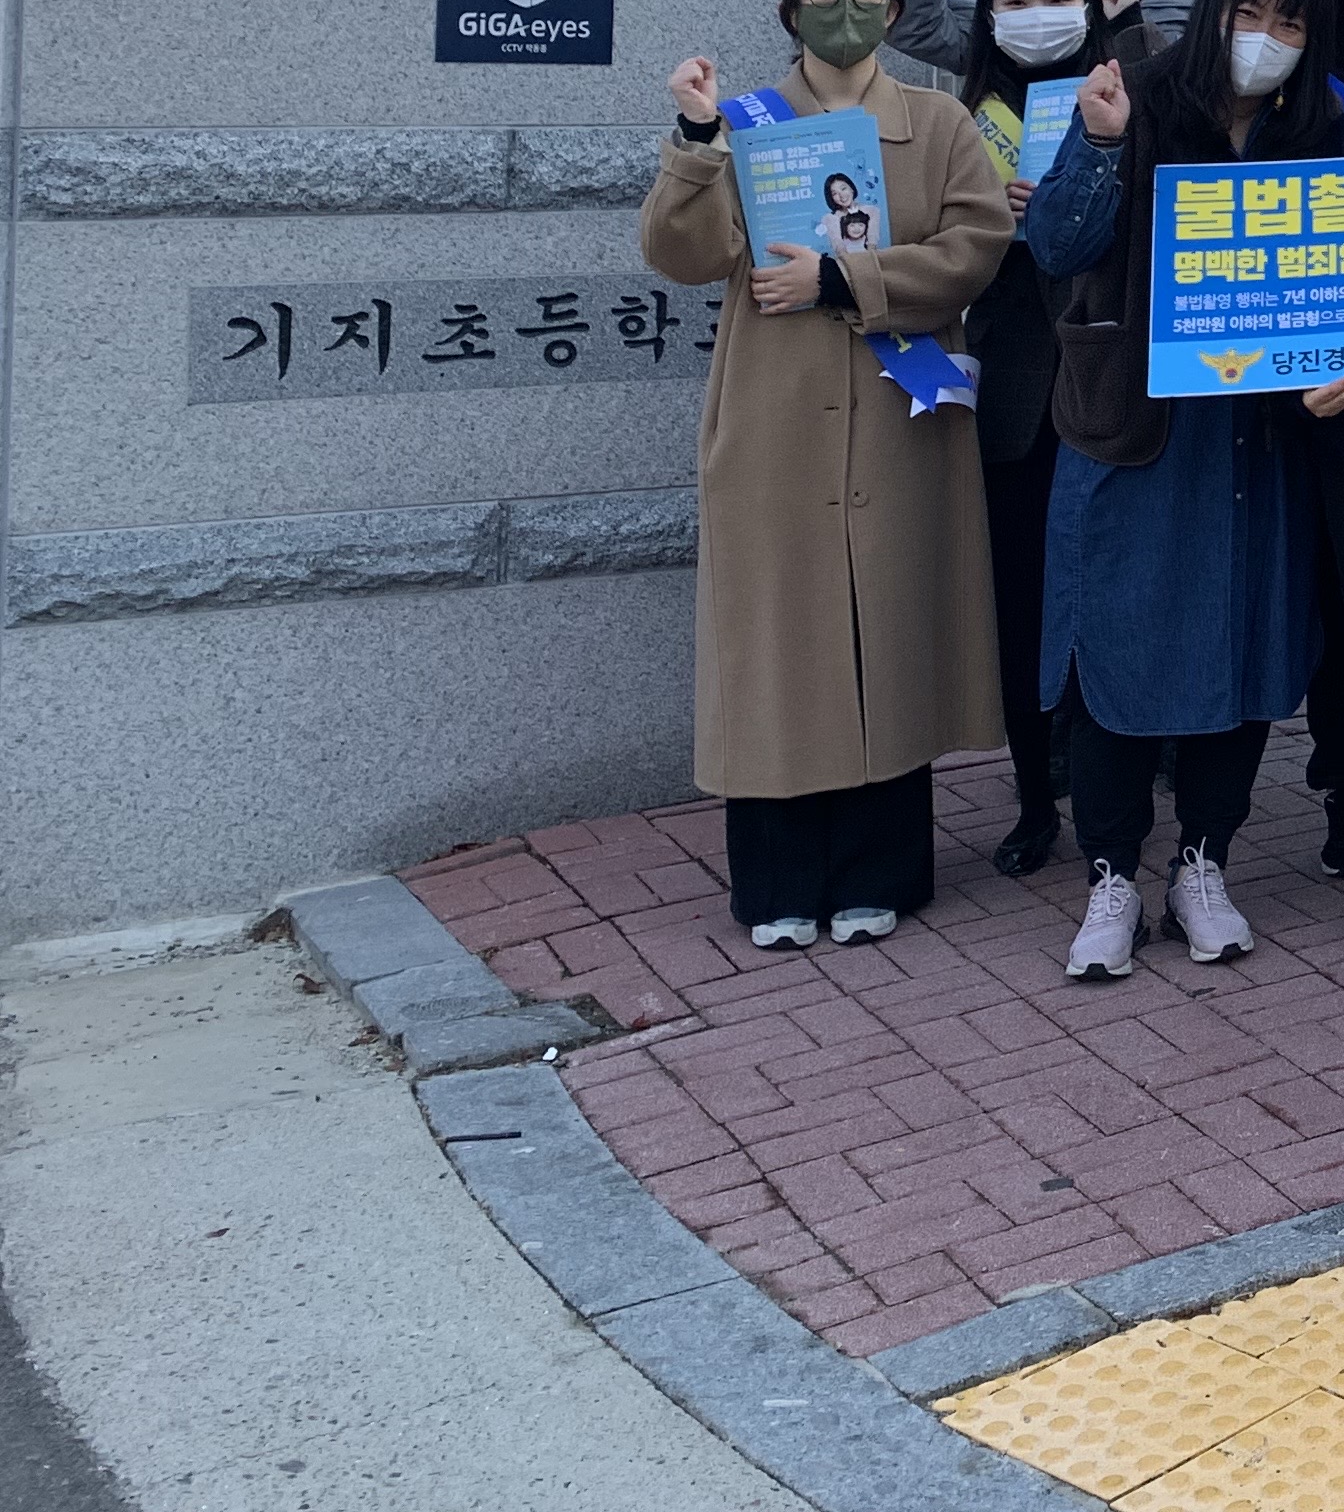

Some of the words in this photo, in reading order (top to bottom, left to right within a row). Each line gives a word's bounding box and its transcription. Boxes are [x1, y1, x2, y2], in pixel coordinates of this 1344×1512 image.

[501, 43, 523, 53] CCTV
[1173, 247, 1268, 285] 명백한
[1174, 292, 1231, 311] 불법촬영
[1236, 291, 1279, 309] 행위는
[1282, 288, 1306, 305] 7년
[1173, 316, 1226, 335] 5천만원
[1230, 313, 1273, 331] 이하의
